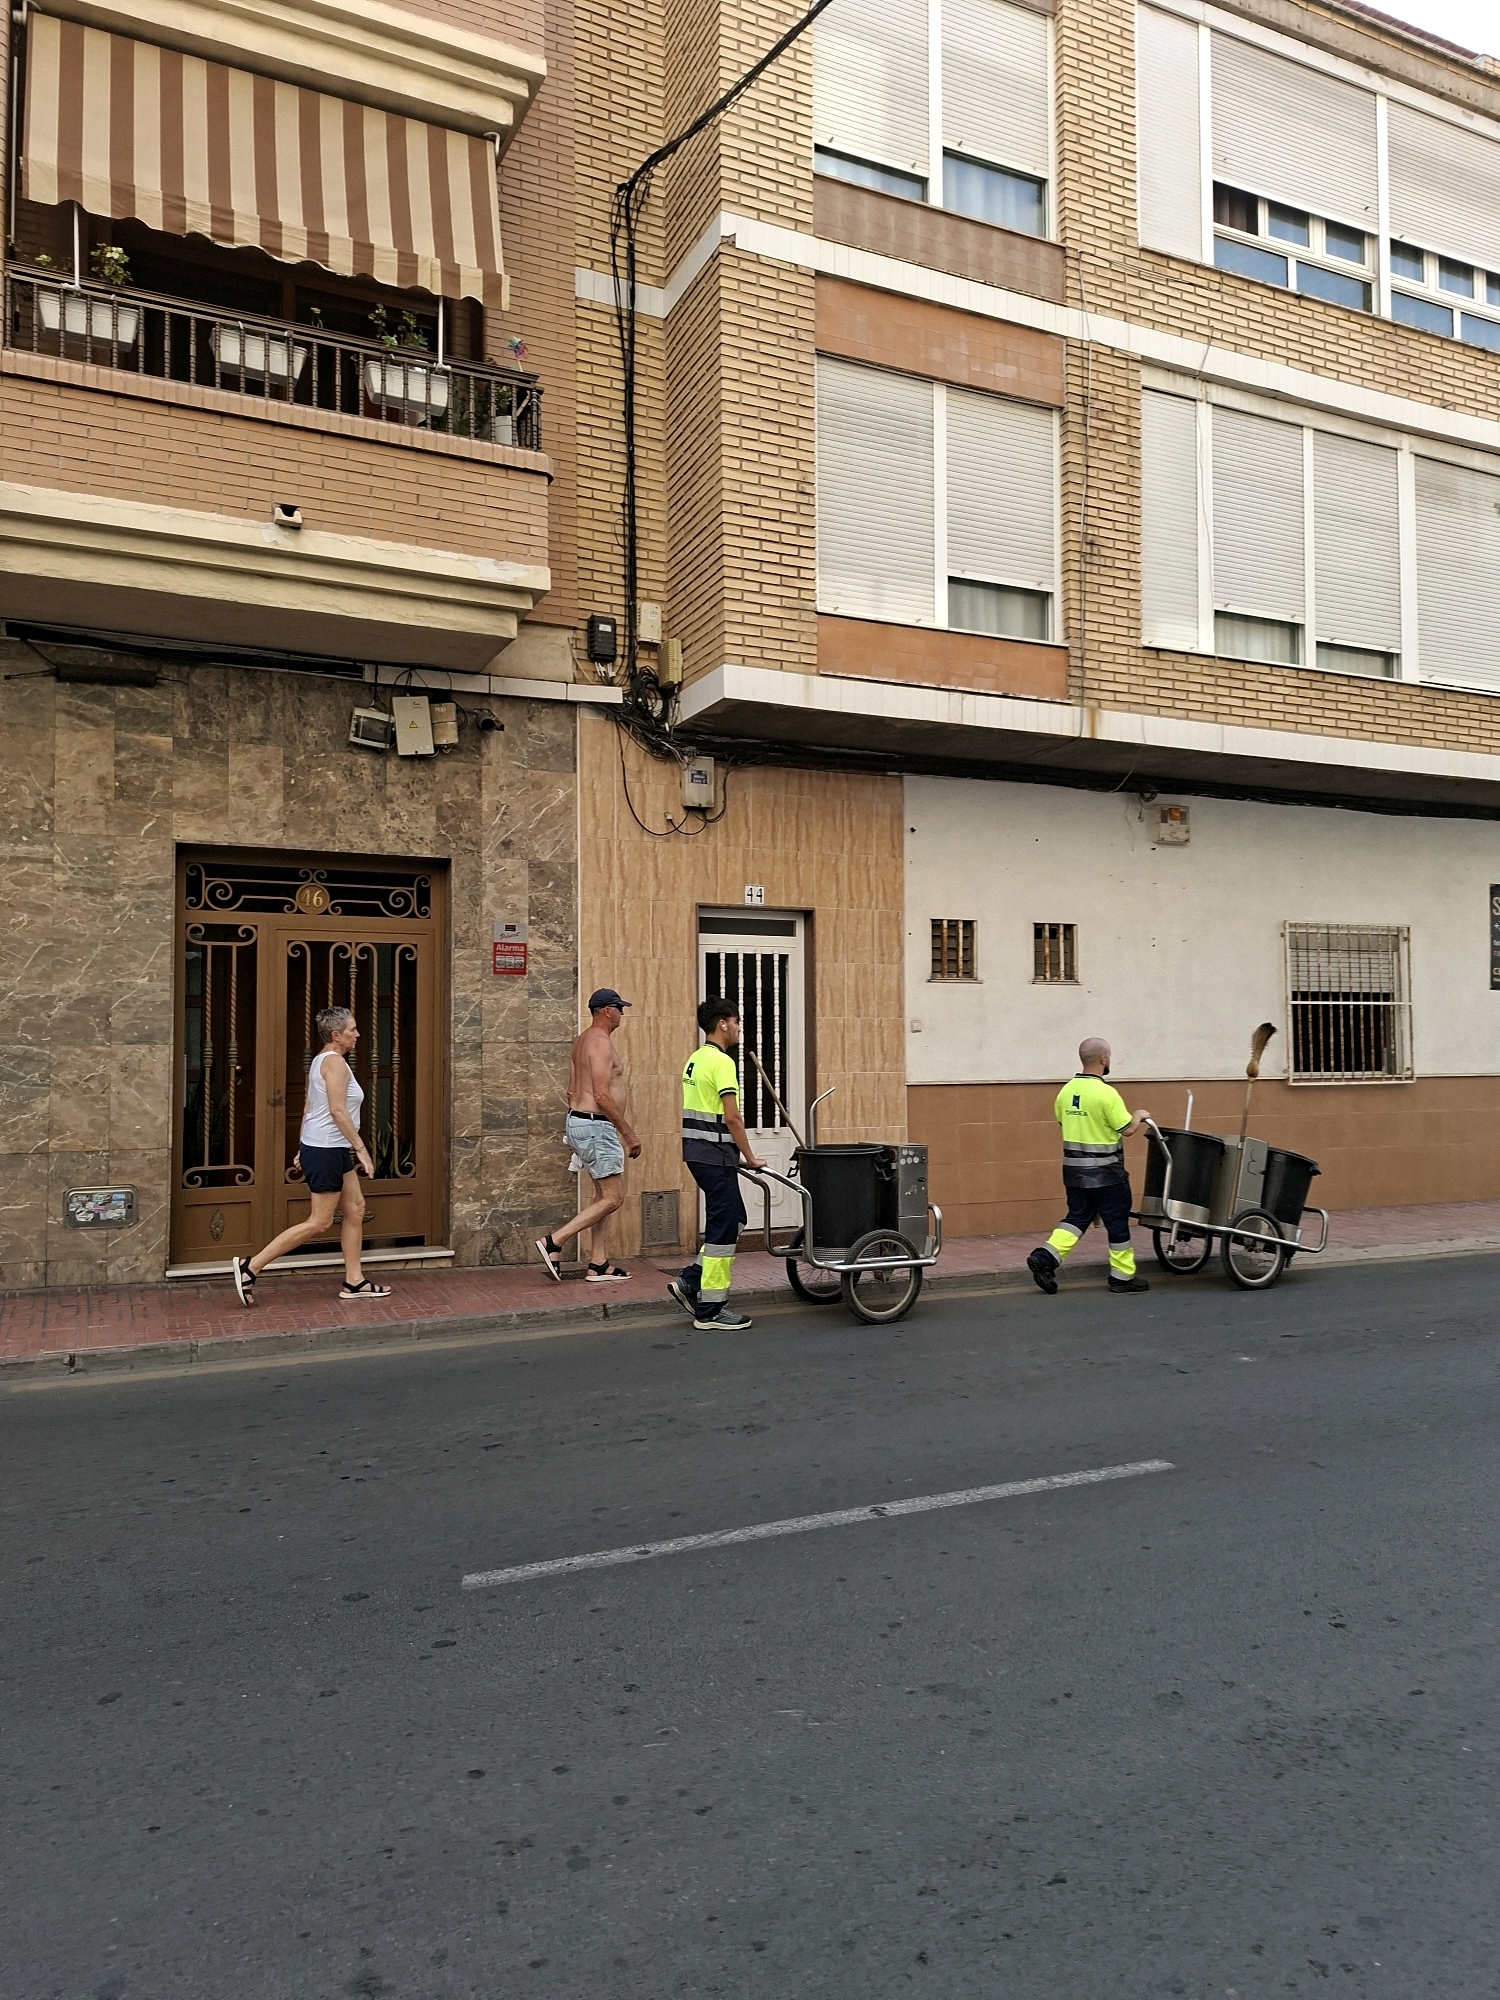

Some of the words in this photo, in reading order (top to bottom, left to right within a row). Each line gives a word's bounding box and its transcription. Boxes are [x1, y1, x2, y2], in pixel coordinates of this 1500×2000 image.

[301, 889, 324, 908] 46
[746, 887, 763, 903] 44
[496, 943, 525, 952] Alarma
